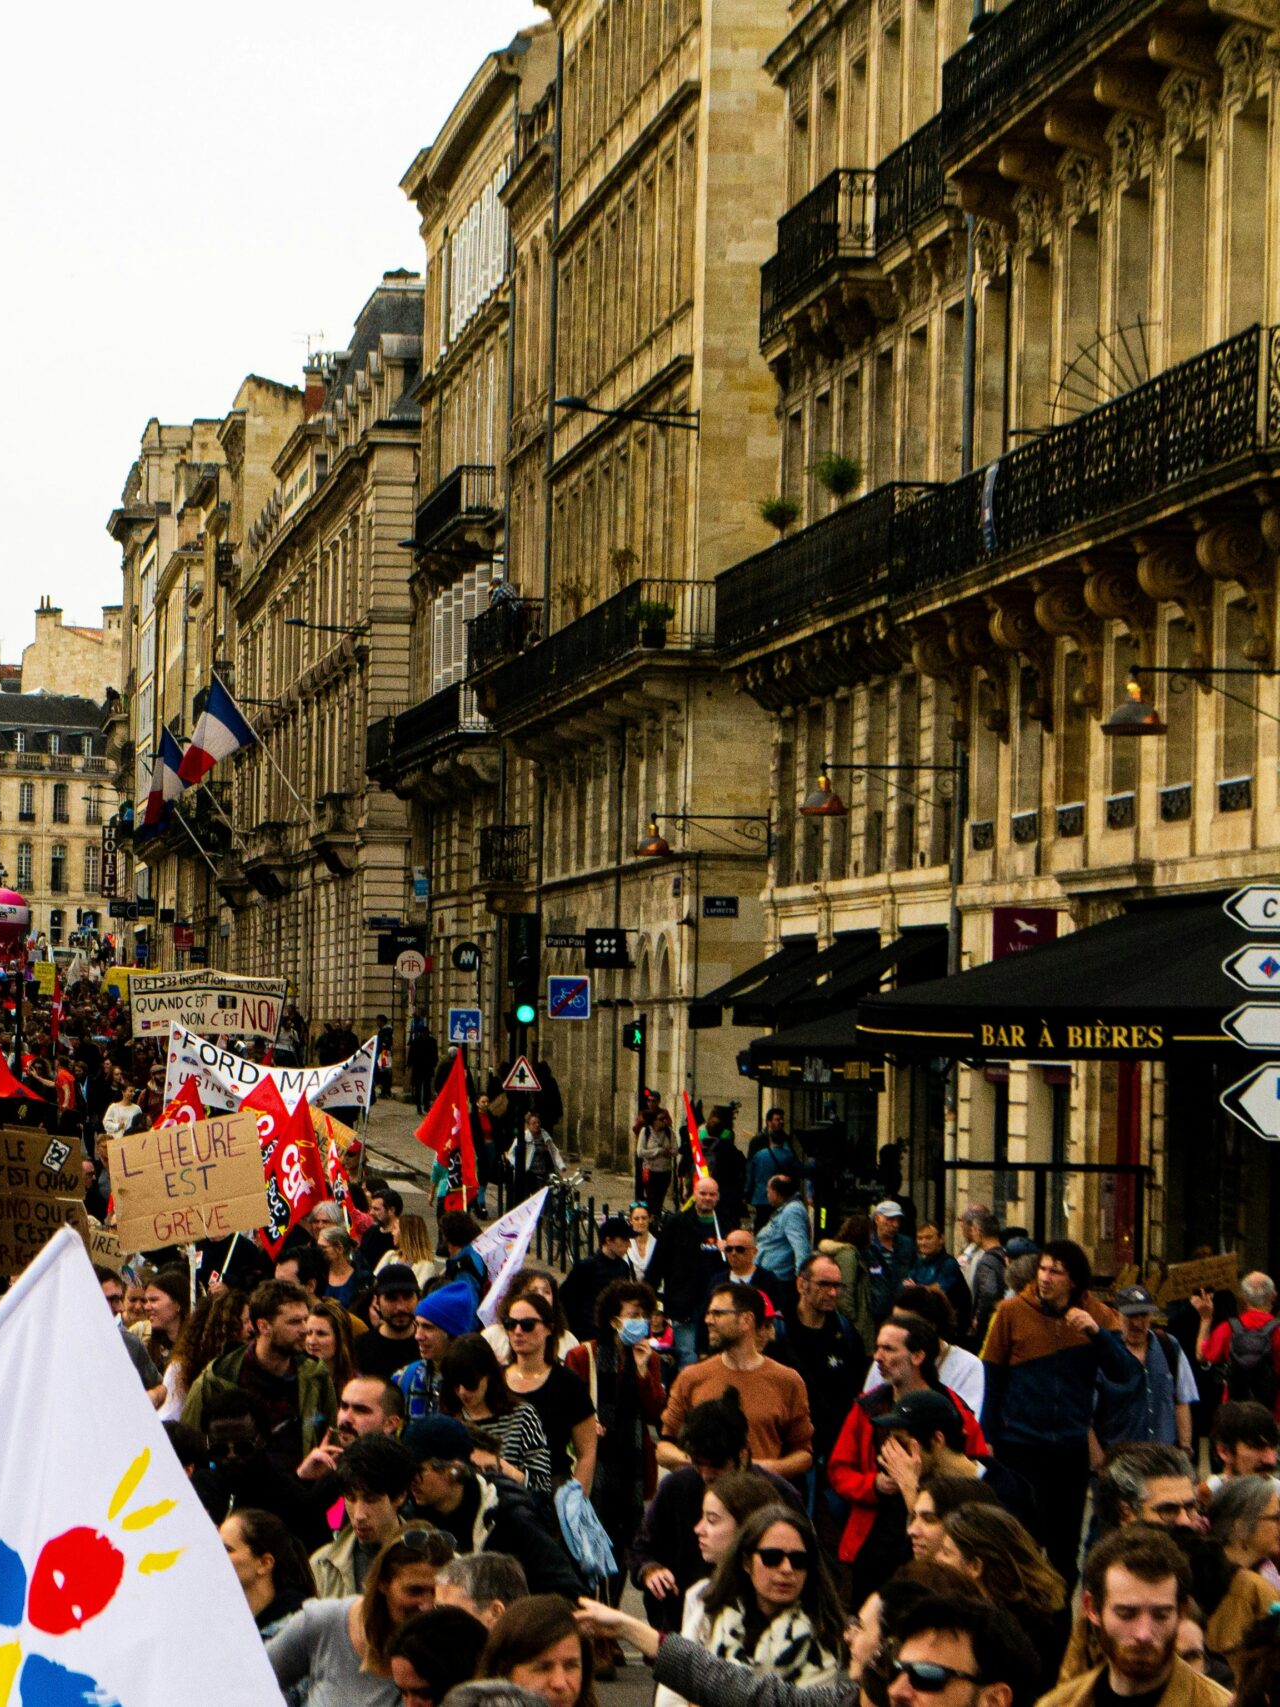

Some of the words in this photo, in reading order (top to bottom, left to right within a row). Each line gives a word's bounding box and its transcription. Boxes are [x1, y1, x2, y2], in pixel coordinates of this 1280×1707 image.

[104, 827, 116, 888] HOTEL
[397, 936, 417, 944] sergic
[547, 937, 566, 945] Pain
[568, 937, 585, 946] Pau
[135, 996, 183, 1013] QUAND
[180, 1012, 205, 1025] NON
[210, 1011, 239, 1026] C'EST
[241, 999, 279, 1035] NON
[981, 1024, 1026, 1047] BAR
[1038, 1018, 1055, 1047] À
[1067, 1018, 1164, 1048] BIÈRES
[182, 1031, 260, 1085] FORD
[4, 1138, 25, 1162] LE
[121, 1117, 246, 1178] L'HEURE
[165, 1163, 217, 1198] EST
[153, 1204, 230, 1241] GRÈVE
